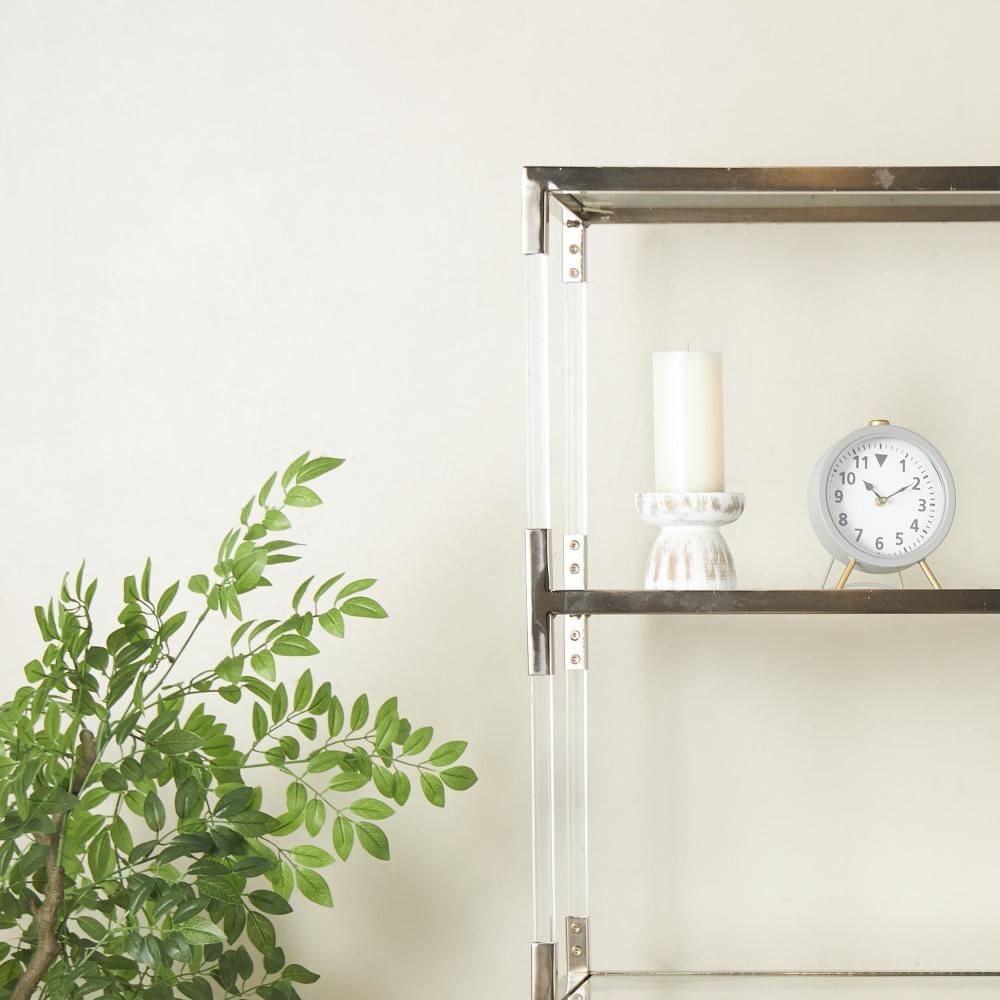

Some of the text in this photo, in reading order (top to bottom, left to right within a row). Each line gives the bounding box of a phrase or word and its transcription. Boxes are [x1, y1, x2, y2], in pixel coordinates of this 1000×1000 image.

[853, 456, 868, 469] 11
[900, 460, 906, 472] 1
[839, 472, 855, 485] 10
[913, 477, 920, 490] 2
[835, 490, 843, 503] 9
[918, 499, 926, 512] 3
[839, 513, 847, 526] 8
[910, 519, 919, 532] 4
[855, 529, 863, 542] 7
[896, 532, 903, 545] 5
[876, 537, 883, 550] 6
